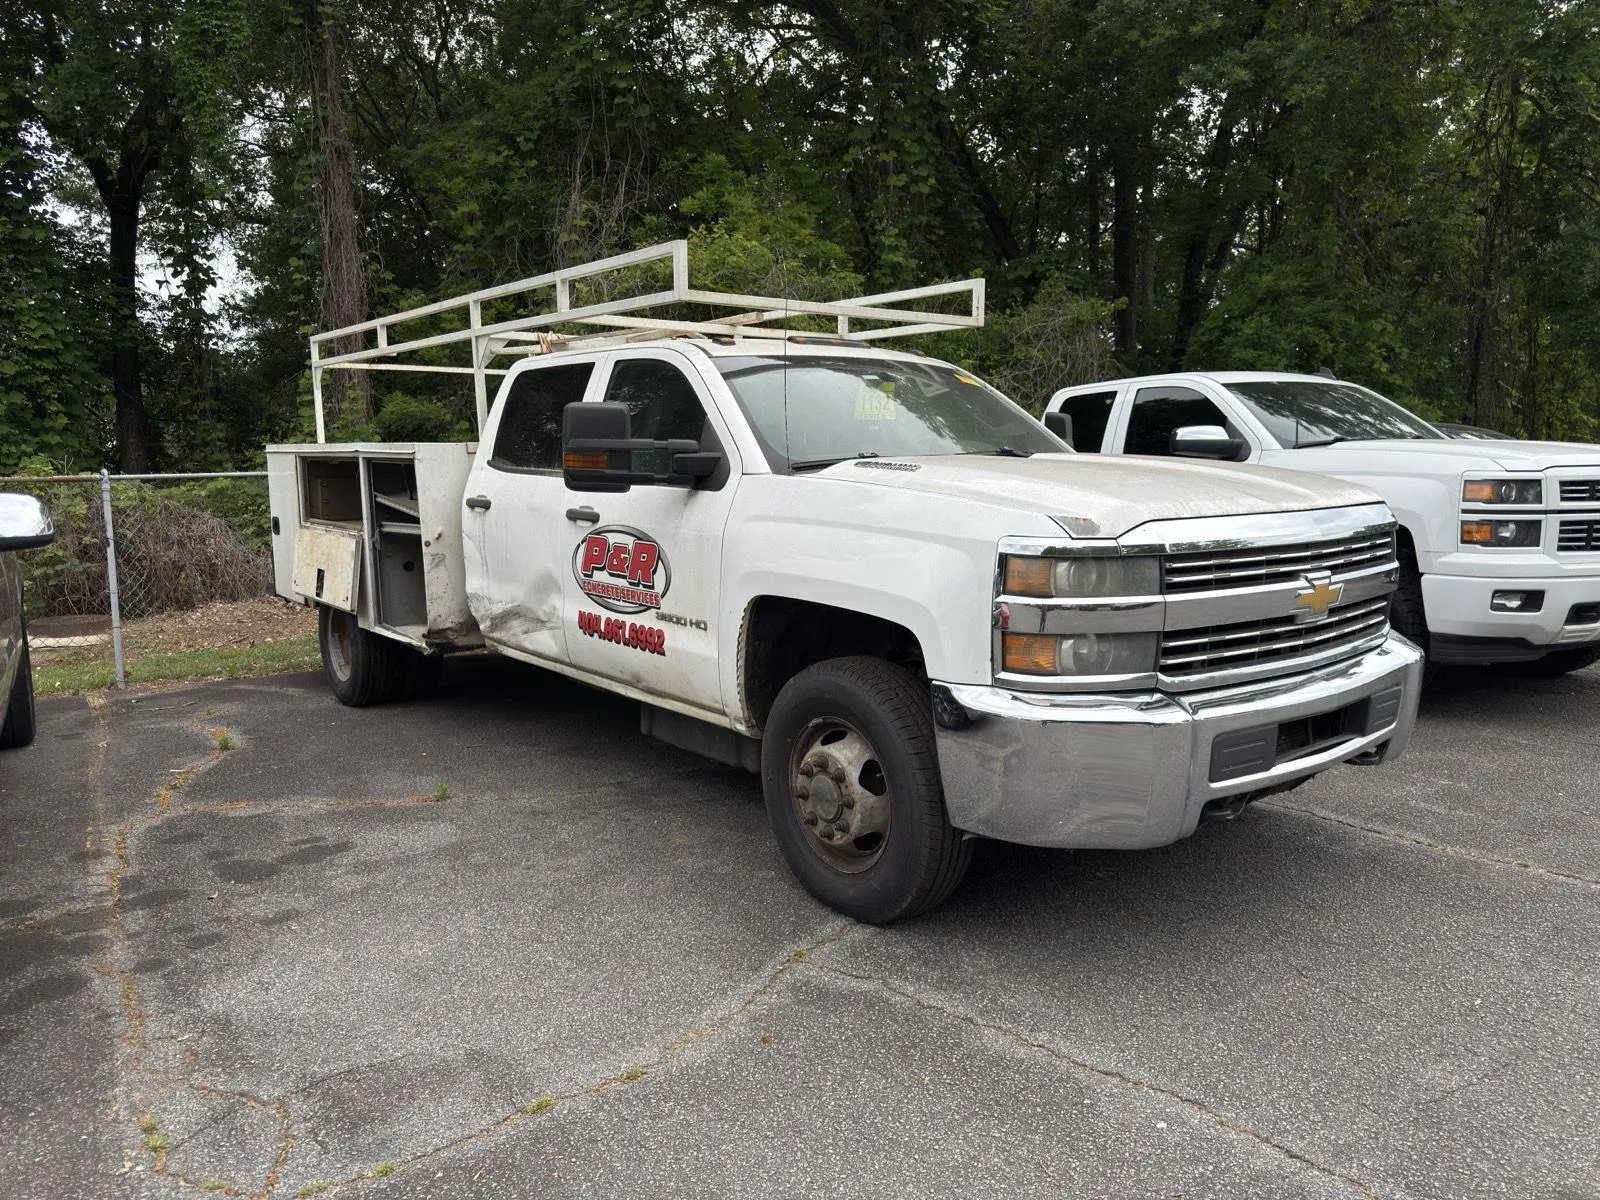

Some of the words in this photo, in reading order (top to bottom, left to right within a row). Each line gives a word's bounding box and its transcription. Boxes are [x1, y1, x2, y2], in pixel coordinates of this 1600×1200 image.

[581, 534, 660, 589] P&R
[582, 579, 620, 601] CONCRETE
[620, 586, 661, 609] SERVICES
